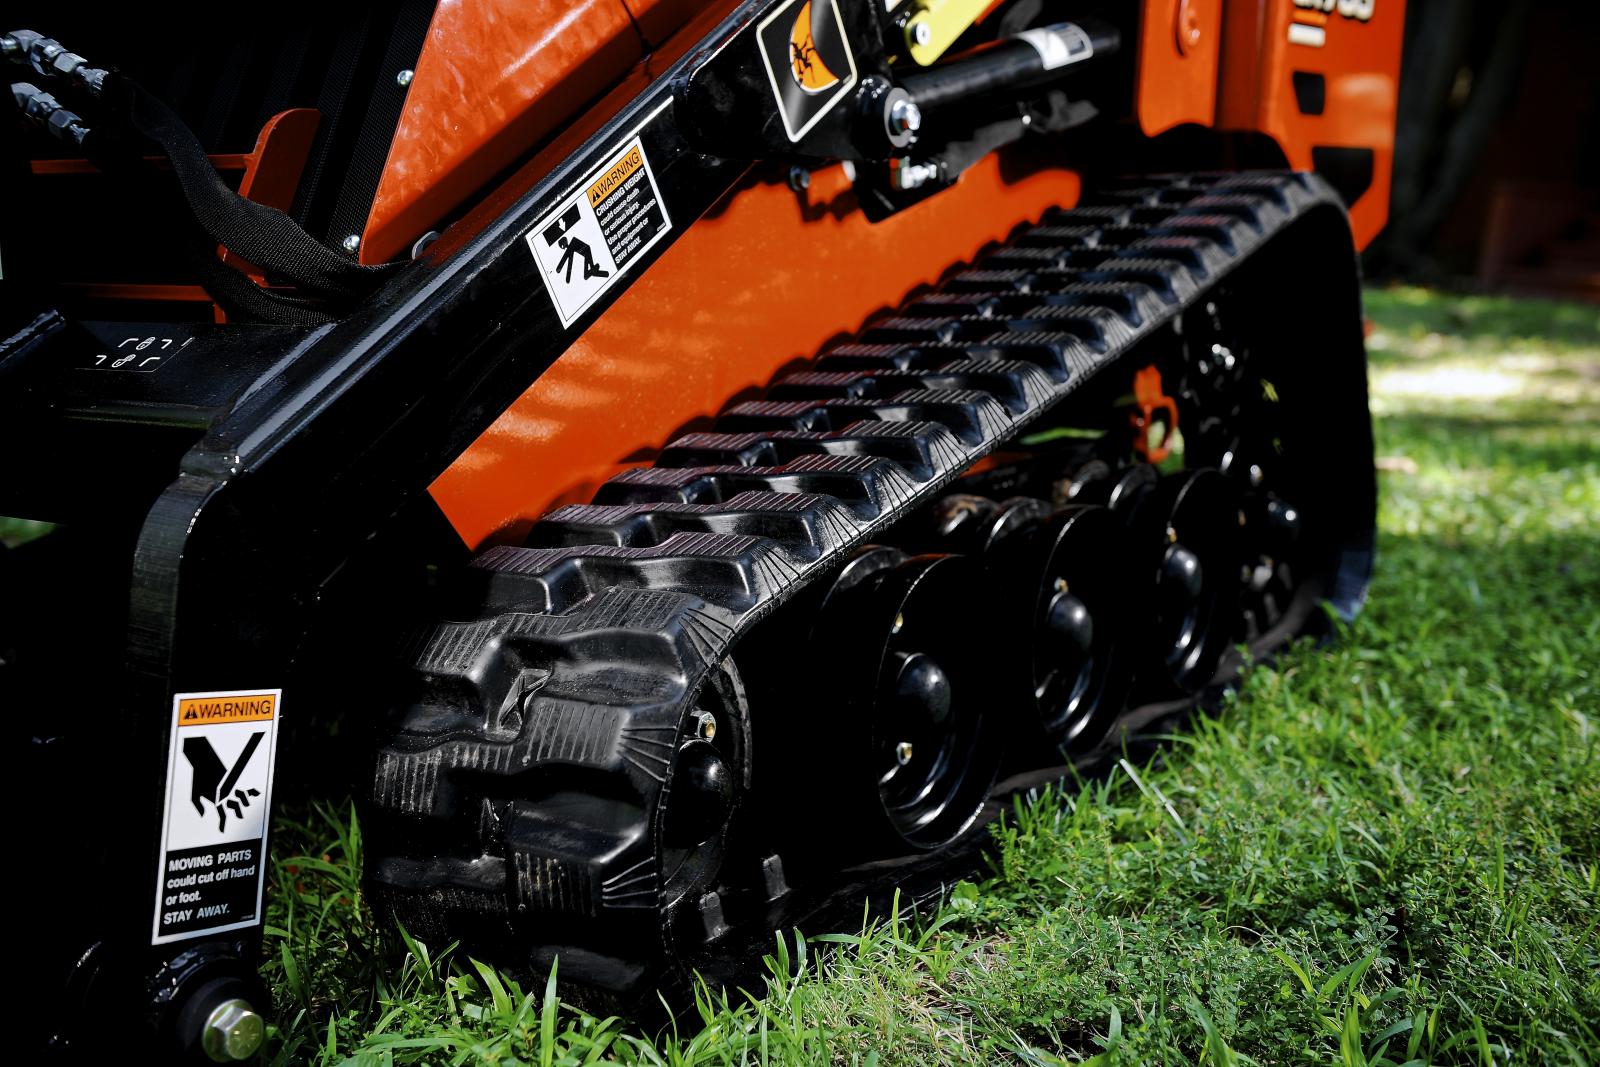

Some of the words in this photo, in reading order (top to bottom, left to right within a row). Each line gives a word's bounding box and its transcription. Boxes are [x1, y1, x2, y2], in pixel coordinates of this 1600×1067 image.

[597, 152, 640, 193] WARNING
[596, 187, 625, 216] CRUSHING
[624, 168, 646, 191] WEIGHT
[601, 212, 614, 226] could
[613, 201, 627, 215] cause
[626, 188, 640, 205] death
[607, 235, 618, 246] Use
[617, 220, 632, 238] proper
[631, 198, 657, 225] procedures
[609, 214, 627, 231] serious
[612, 243, 621, 255] and
[620, 221, 644, 247] equipment
[615, 248, 628, 264] STAY
[199, 700, 271, 719] WARNING
[168, 854, 213, 872] MOVING
[217, 849, 252, 864] PARTS
[167, 873, 197, 889] could
[197, 871, 215, 884] cut
[215, 868, 230, 881] off
[230, 864, 255, 879] hand
[165, 895, 178, 906] or
[178, 890, 202, 904] foot.
[163, 909, 193, 925] STAY
[196, 903, 230, 919] AWAY.
